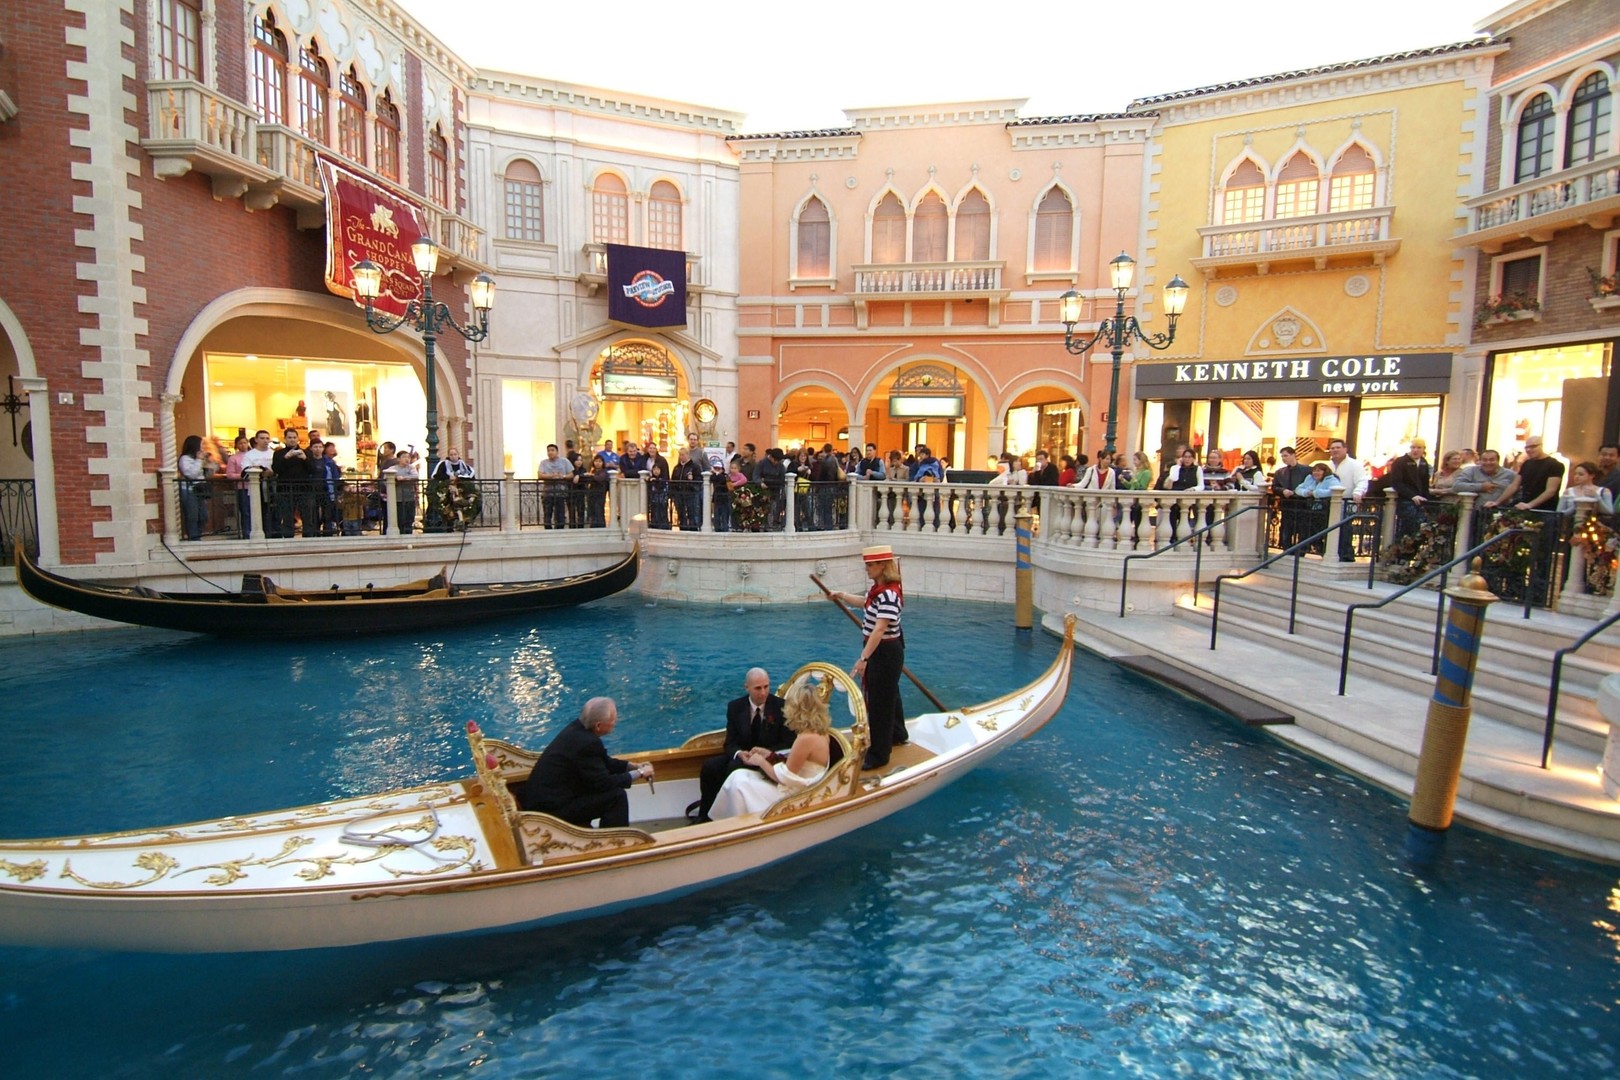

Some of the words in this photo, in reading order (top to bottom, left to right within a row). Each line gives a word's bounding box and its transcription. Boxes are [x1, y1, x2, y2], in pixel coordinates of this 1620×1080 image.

[346, 226, 386, 253] GRAND
[387, 242, 416, 266] CANA
[366, 249, 405, 270] SHOPPES
[1175, 361, 1310, 381] KENNETH
[1321, 357, 1400, 377] COLE
[1322, 382, 1355, 393] new
[1361, 379, 1398, 394] york
